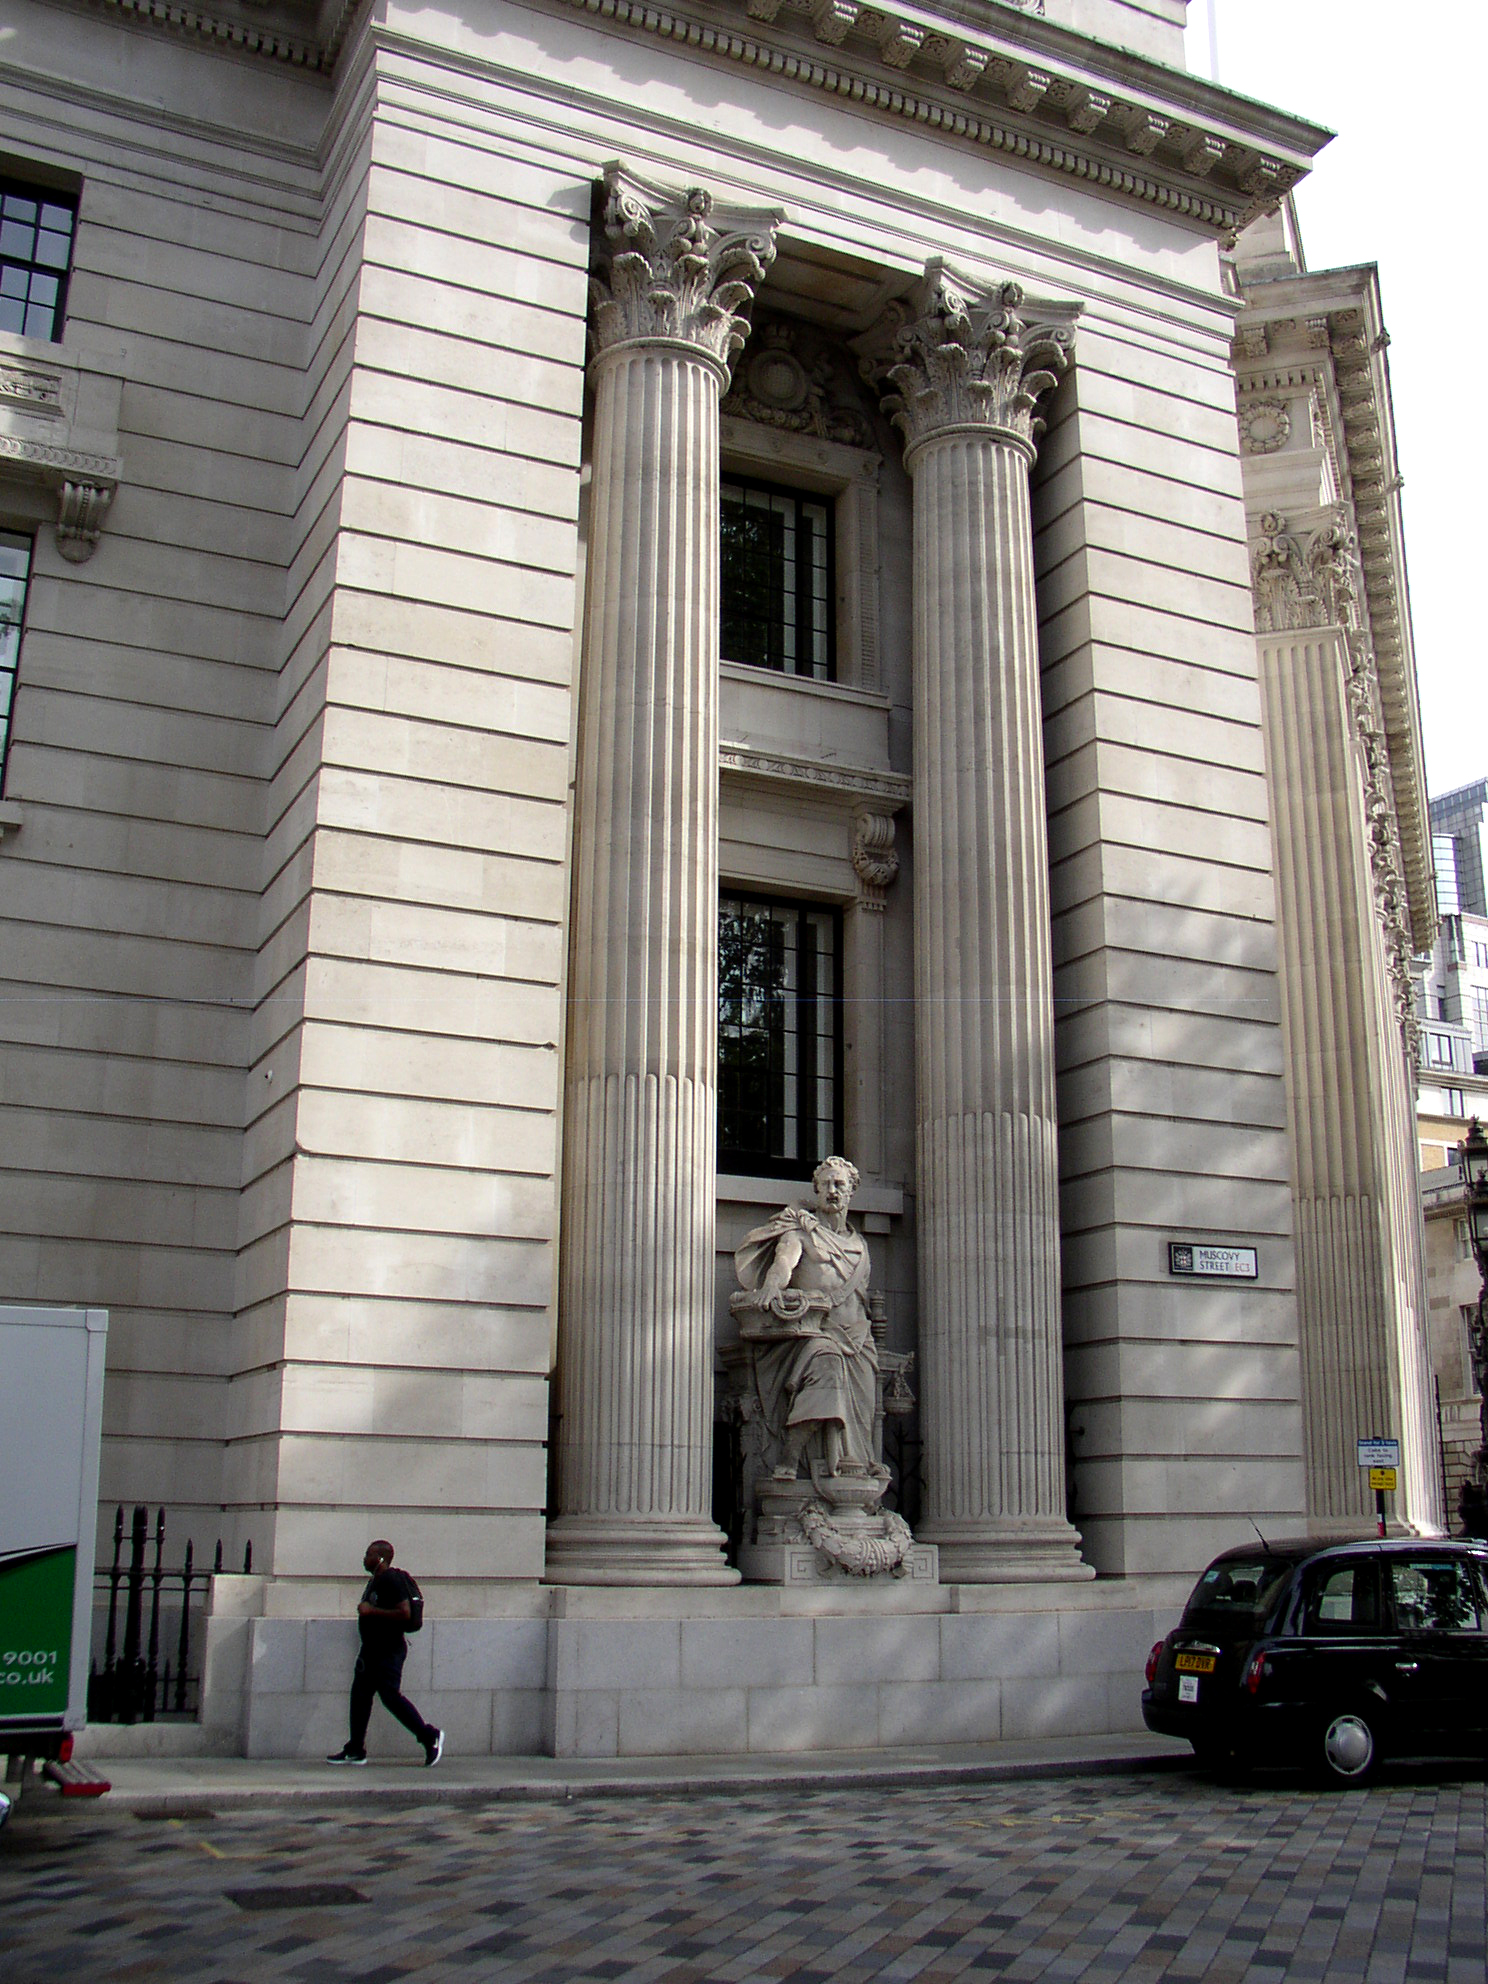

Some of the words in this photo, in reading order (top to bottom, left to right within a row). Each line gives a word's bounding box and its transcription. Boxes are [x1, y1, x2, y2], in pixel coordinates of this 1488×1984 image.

[1199, 1250, 1240, 1261] MUSCOVY
[1200, 1260, 1230, 1271] STREET
[3, 1651, 57, 1665] 9001
